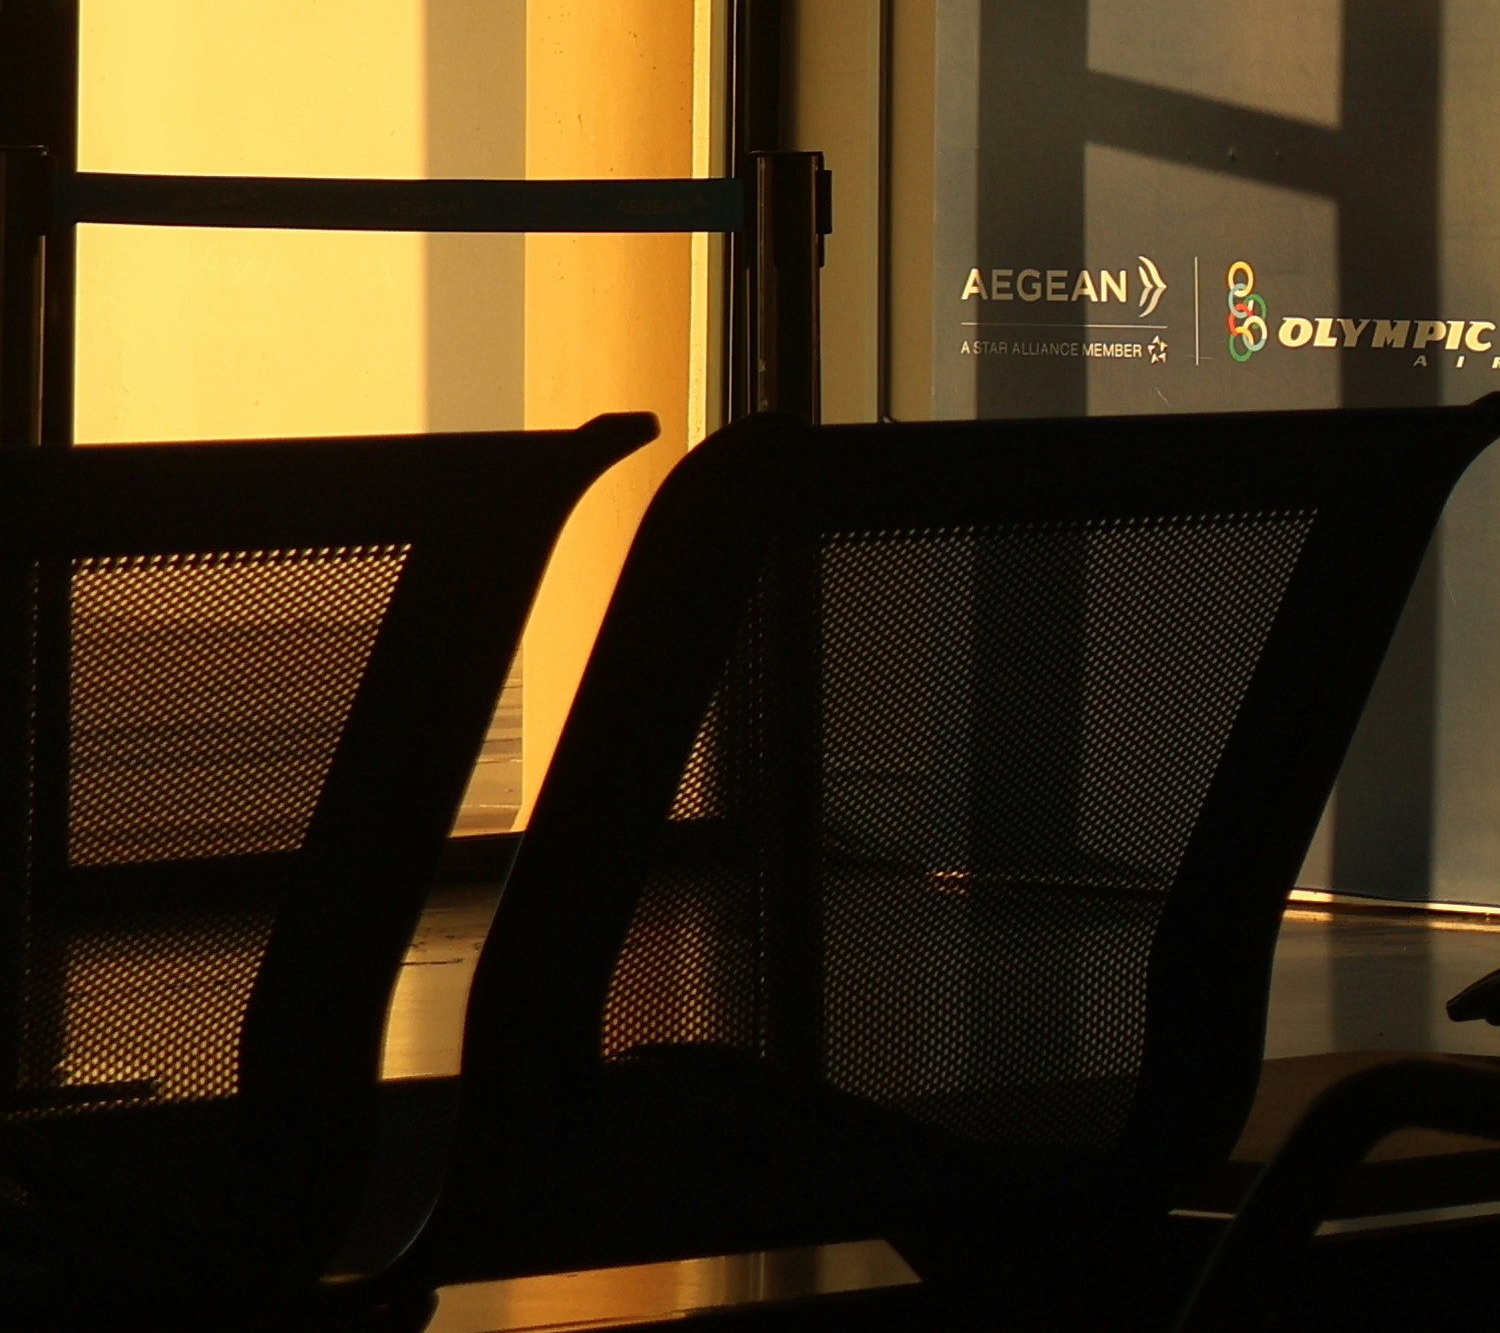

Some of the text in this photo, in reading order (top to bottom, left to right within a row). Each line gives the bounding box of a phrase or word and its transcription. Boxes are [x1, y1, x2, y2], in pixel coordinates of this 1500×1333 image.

[960, 267, 1128, 304] AEGEAN
[960, 340, 1143, 359] A STAR ALLIANCE MEMBER
[1277, 315, 1498, 353] OLYMPIC
